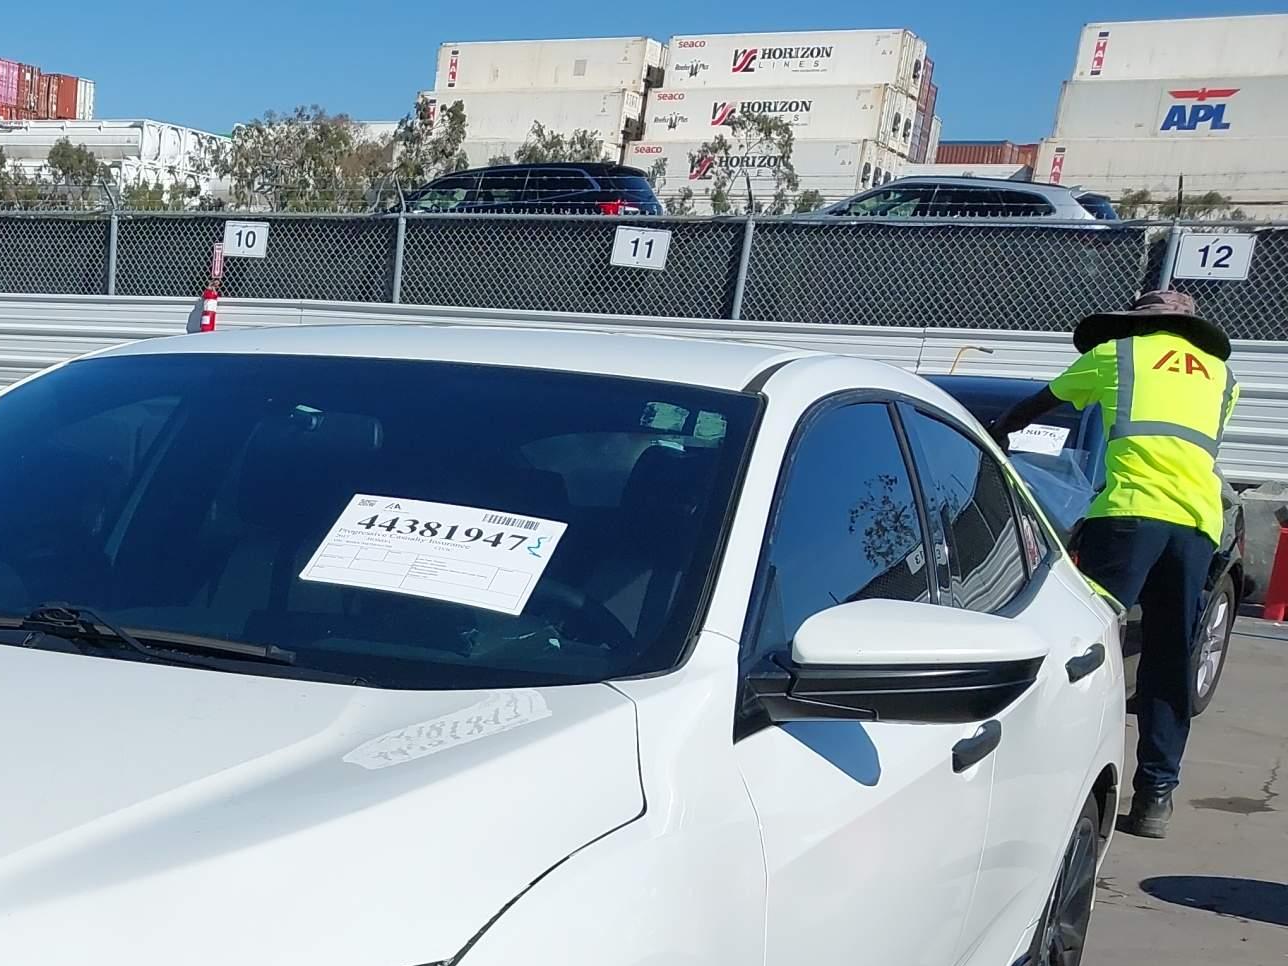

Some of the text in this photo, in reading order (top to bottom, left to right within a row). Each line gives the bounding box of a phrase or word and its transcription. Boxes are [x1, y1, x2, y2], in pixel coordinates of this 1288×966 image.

[678, 39, 706, 49] seaco
[760, 46, 833, 60] HORIZON
[1092, 40, 1108, 69] TAL
[758, 60, 820, 69] LINES
[657, 92, 685, 101] seaco
[739, 100, 813, 113] HORIZON
[1160, 103, 1231, 131] APL
[634, 145, 662, 154] seaco
[235, 229, 257, 249] 10
[630, 237, 654, 259] 11
[1198, 244, 1234, 268] 12
[357, 513, 529, 551] 44381947
